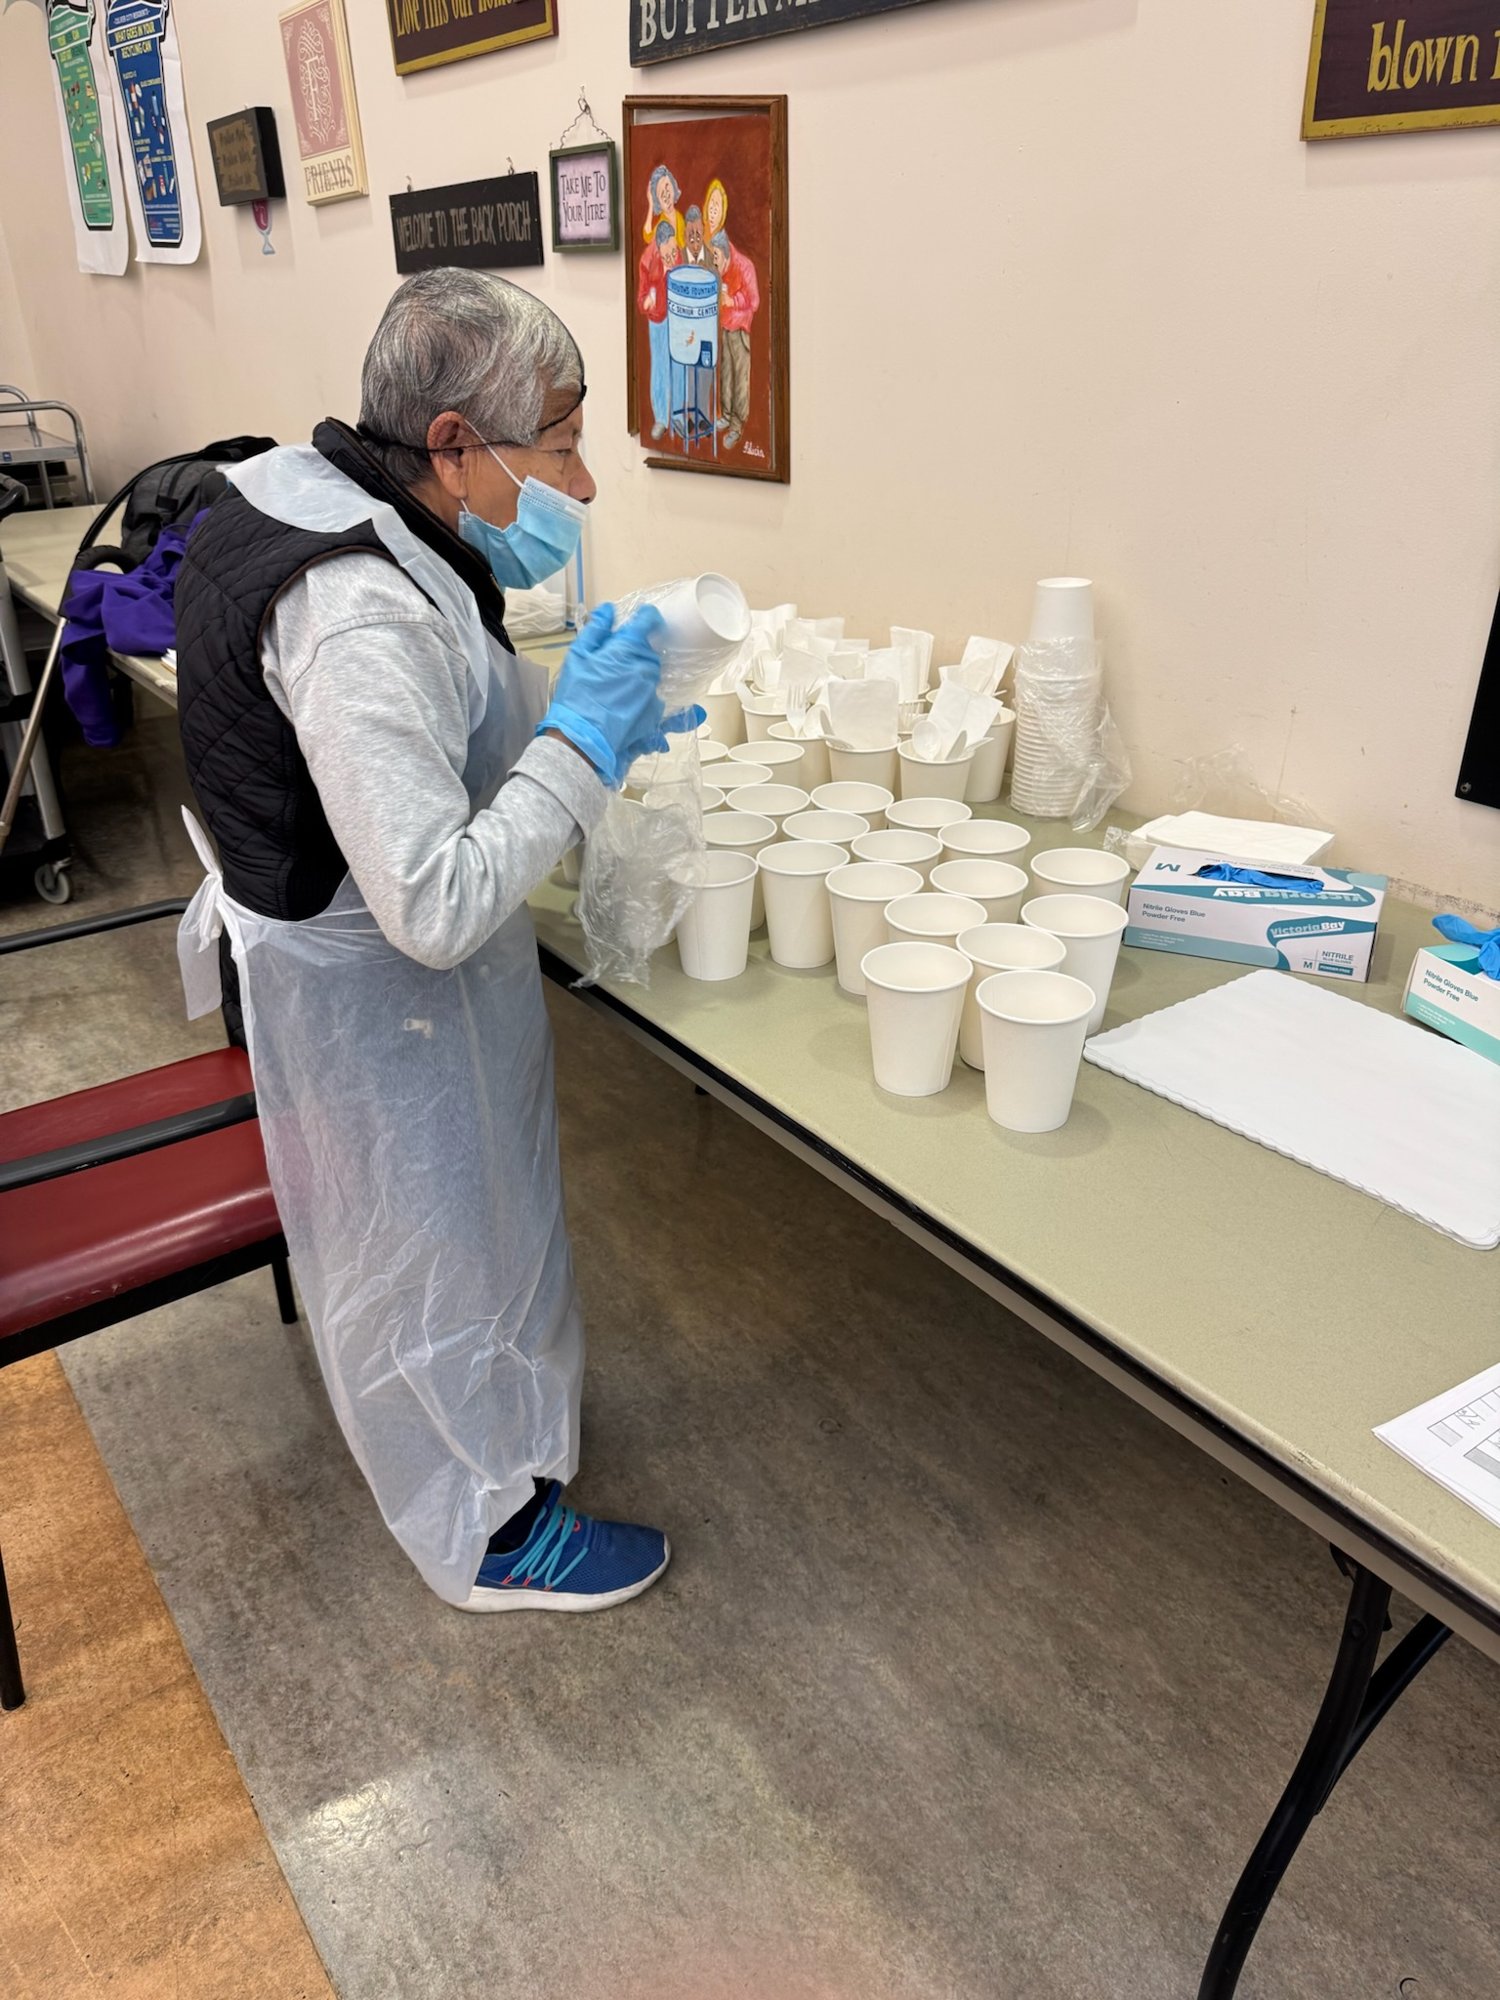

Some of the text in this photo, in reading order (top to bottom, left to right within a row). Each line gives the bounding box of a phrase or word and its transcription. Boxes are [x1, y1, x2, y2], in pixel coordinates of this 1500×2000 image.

[1366, 19, 1480, 93] blown
[304, 155, 354, 196] FRIENDS
[560, 170, 606, 200] TAKE ME TO
[396, 200, 532, 252] WELCOME TO THE BACK PORCH
[562, 201, 583, 228] YOUR
[1142, 903, 1206, 918] Nitrile Gloves Blue
[1142, 911, 1186, 923] Powder Free
[1303, 961, 1313, 969] M
[1322, 950, 1354, 961] NITRILE
[1423, 978, 1460, 1002] Powder Free
[1425, 969, 1479, 1002] Nitrile Gloves Blue
